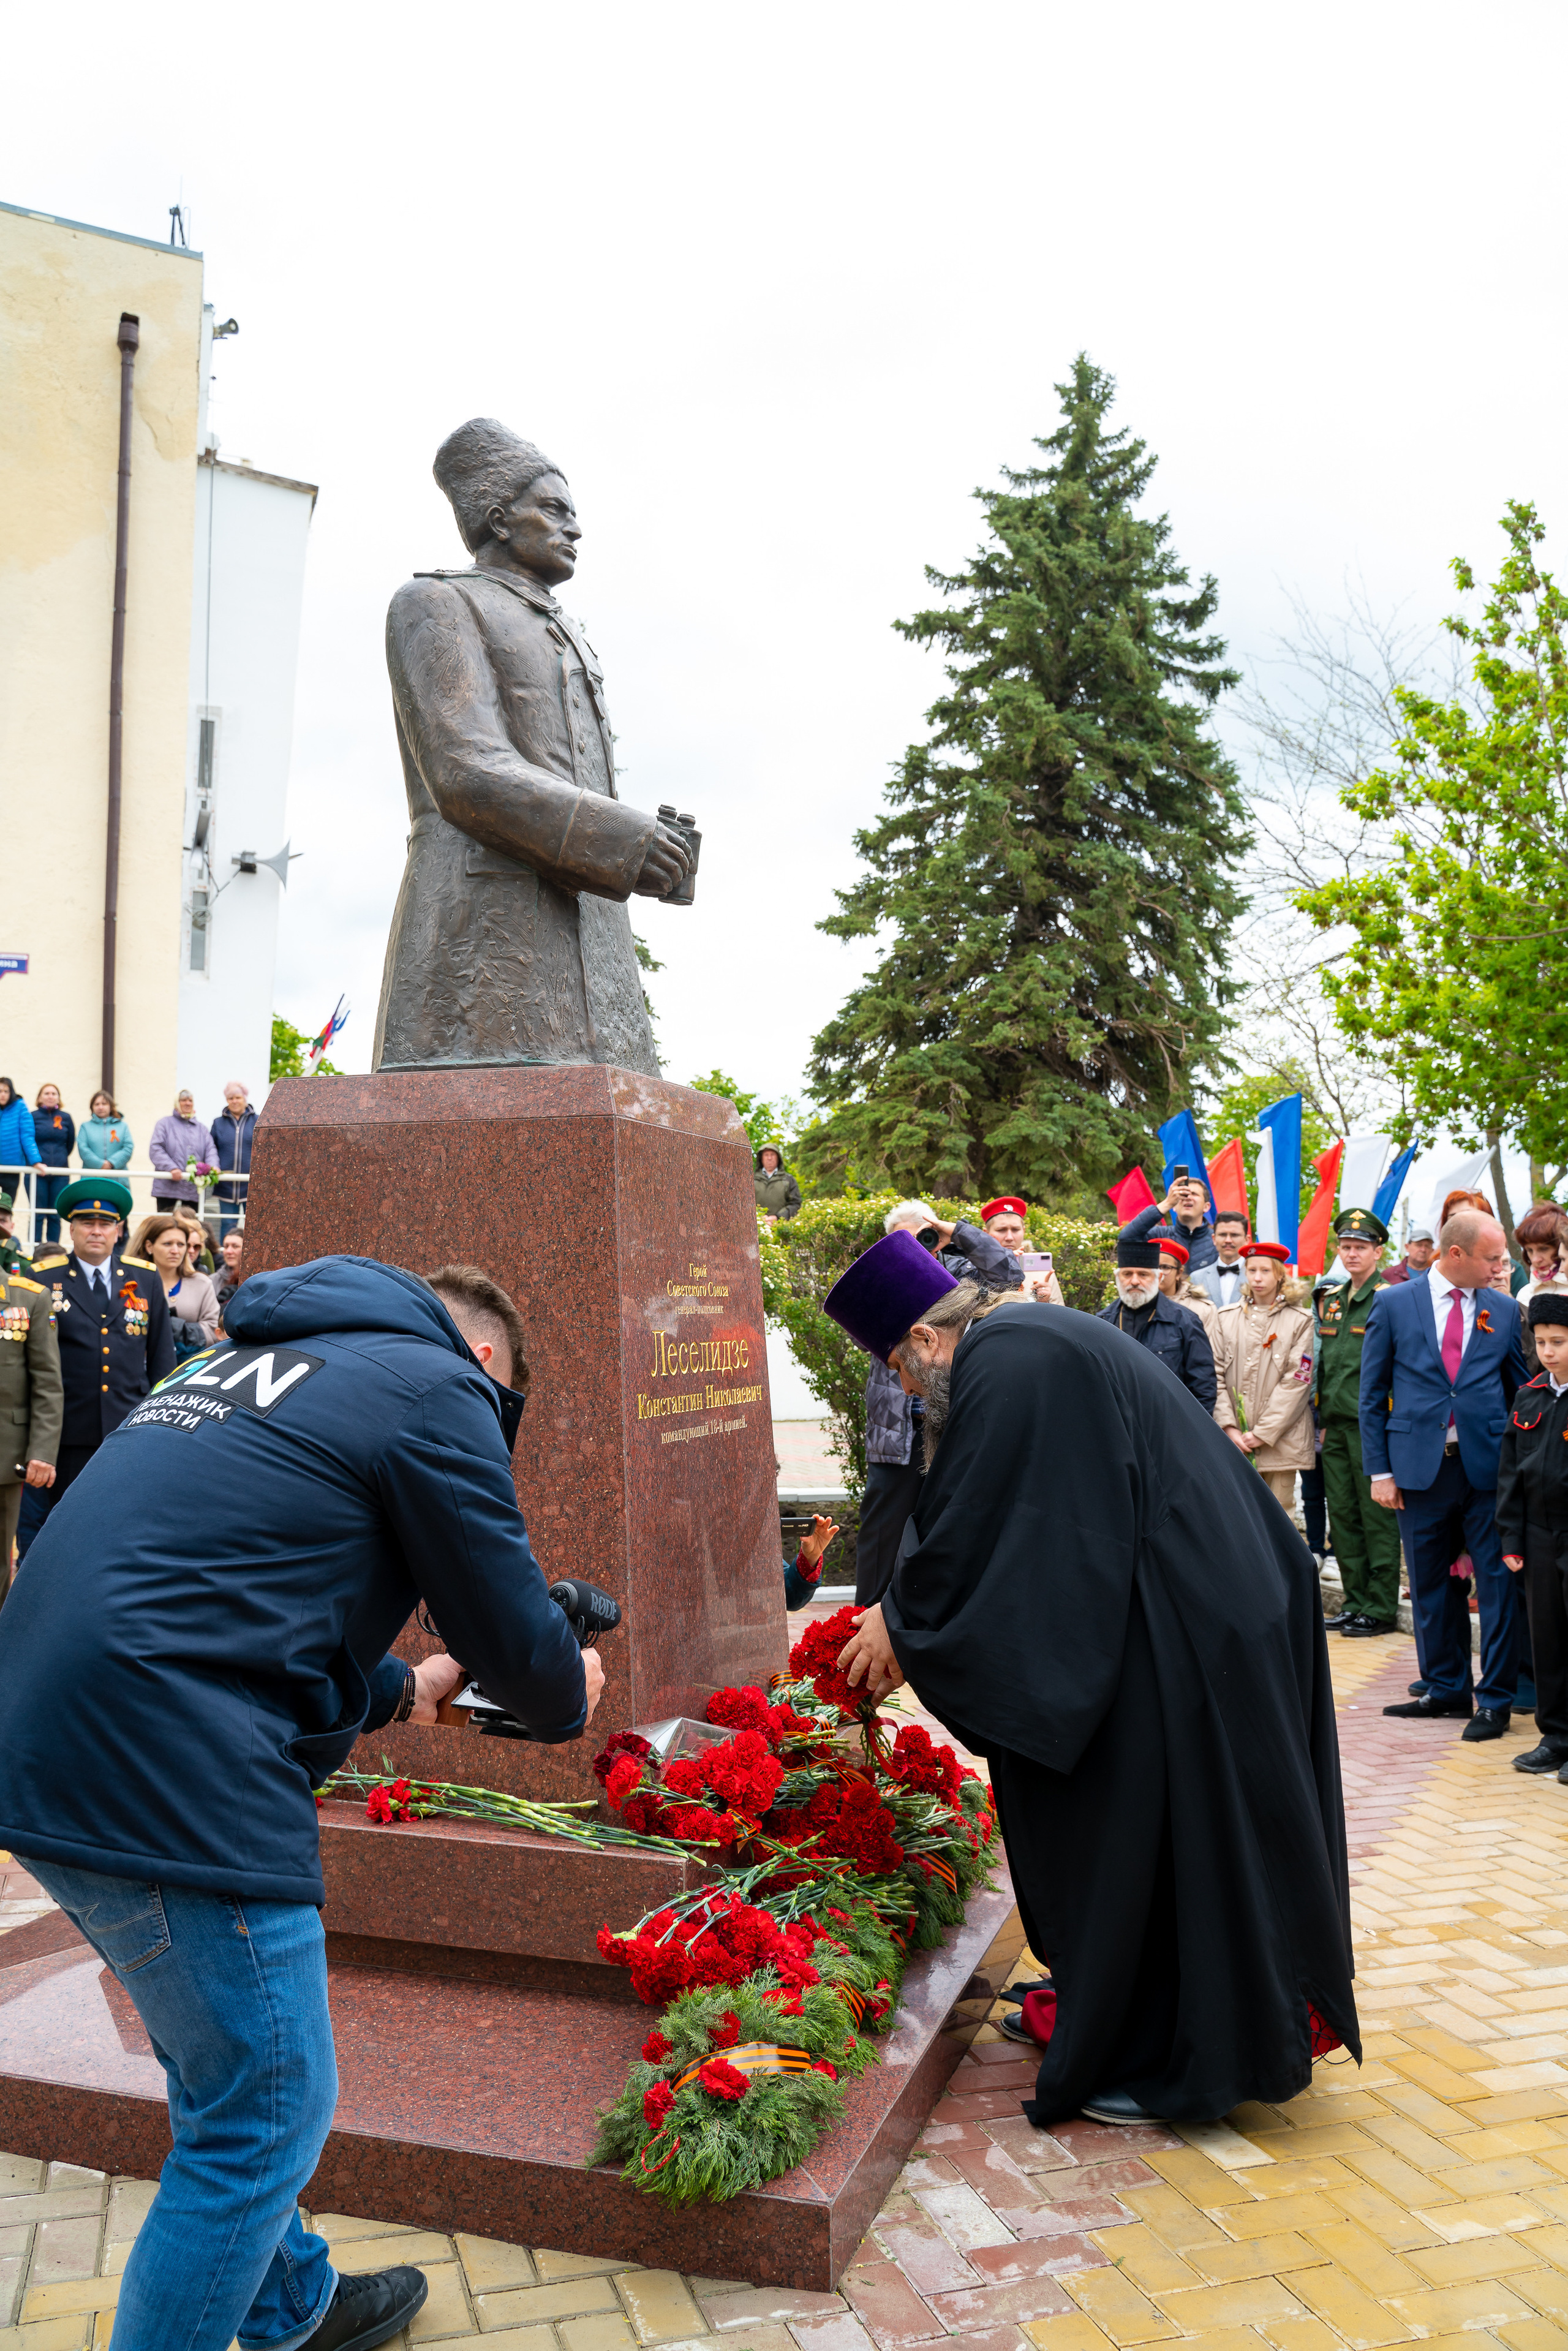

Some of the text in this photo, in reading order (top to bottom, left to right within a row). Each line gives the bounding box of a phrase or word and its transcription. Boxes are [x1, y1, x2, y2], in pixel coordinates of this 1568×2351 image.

[689, 1263, 707, 1280] Герой
[667, 1280, 729, 1297] Советского Союза
[675, 1304, 724, 1318] генерал-полковник
[651, 1329, 748, 1378] Леселидзе
[637, 1384, 763, 1420] Константин Николаевич
[127, 1408, 202, 1429] НОВОСТИ
[661, 1421, 709, 1444] командующий
[710, 1419, 724, 1433] 18-й
